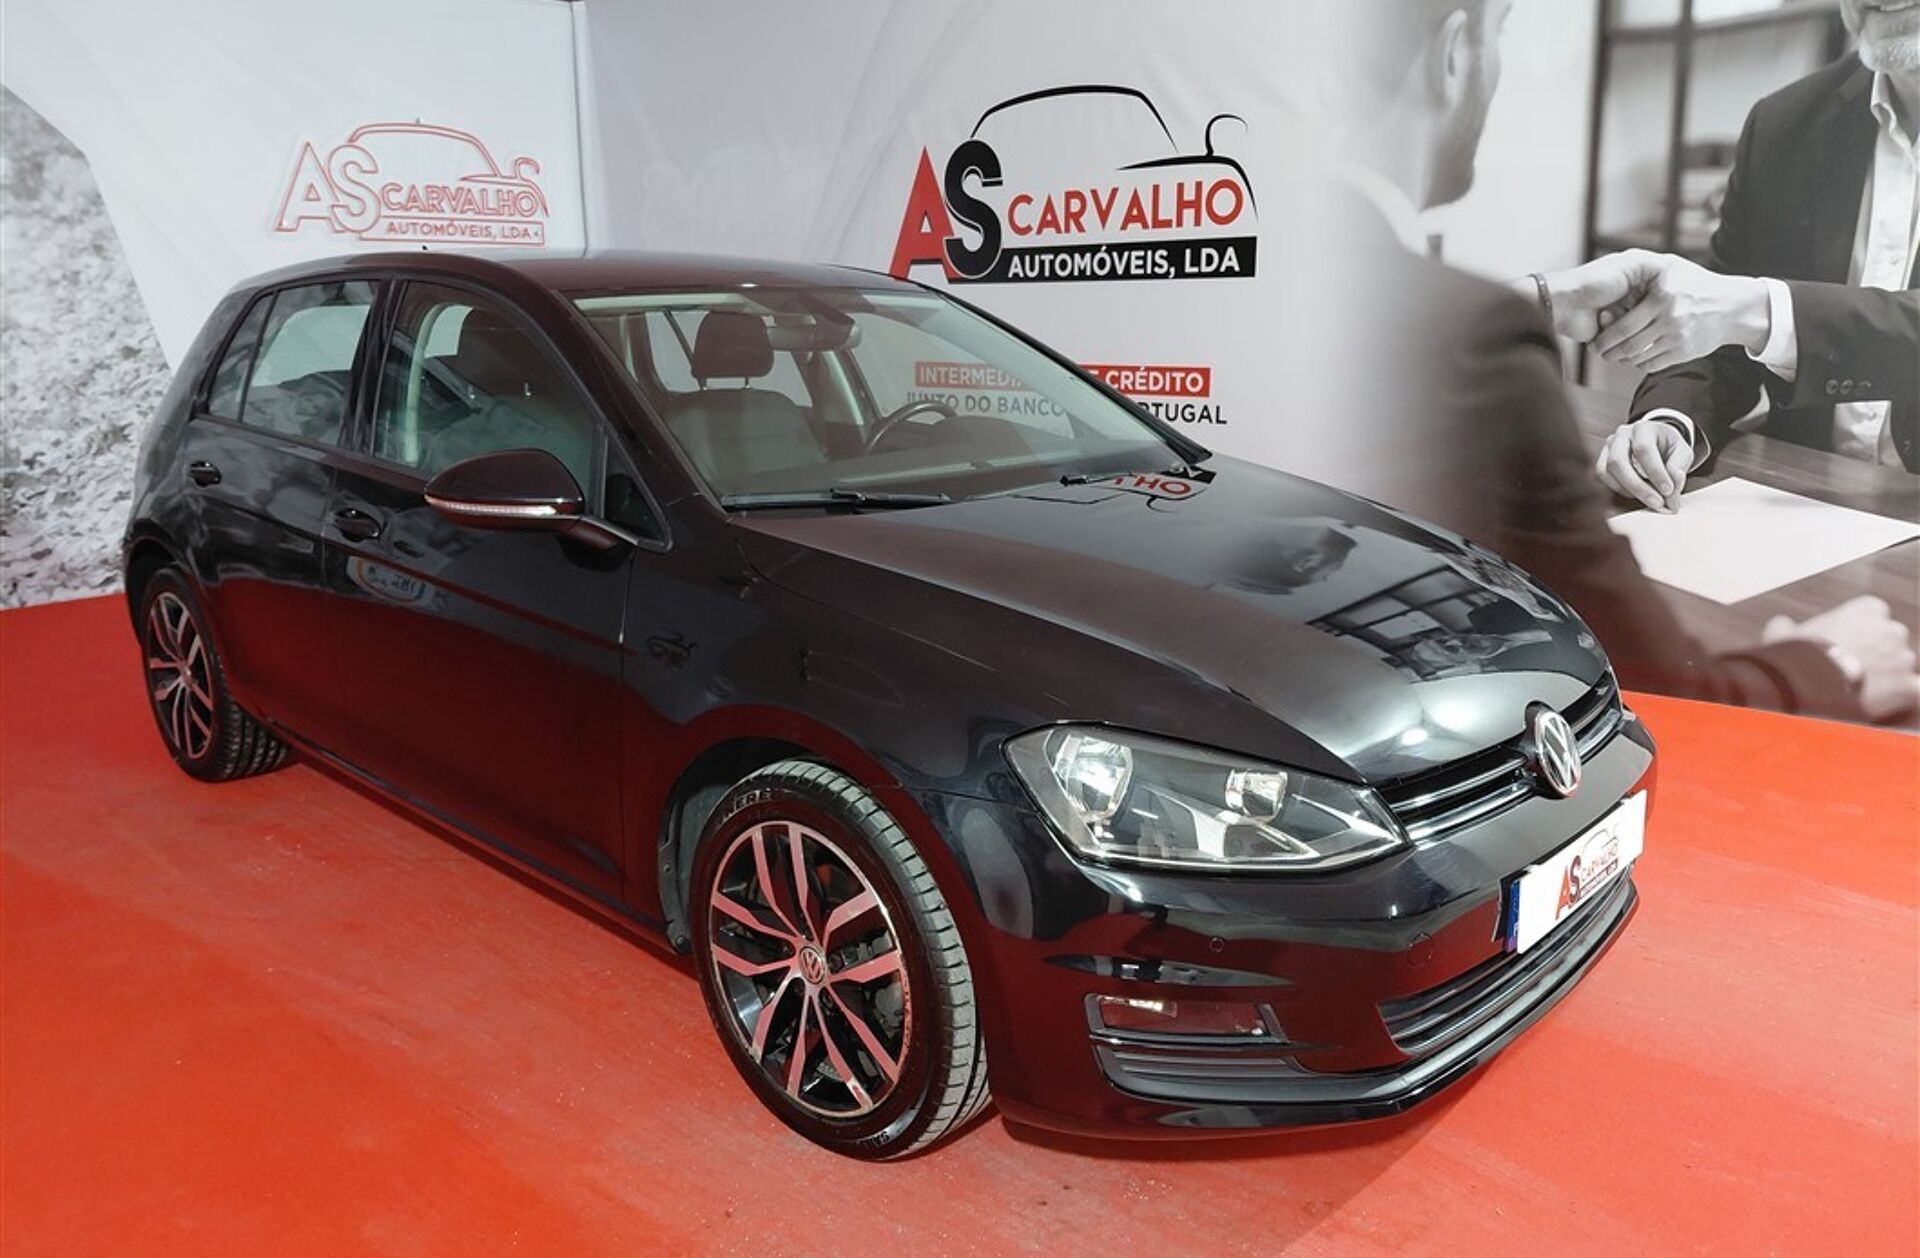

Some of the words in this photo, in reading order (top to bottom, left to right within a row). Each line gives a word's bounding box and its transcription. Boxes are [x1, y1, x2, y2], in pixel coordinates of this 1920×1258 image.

[276, 141, 381, 233] AS
[379, 182, 538, 217] CARVALHO
[889, 139, 1003, 282] AS
[1008, 178, 1244, 236] CARVALHO
[386, 220, 497, 240] AUTOMÓVEIS,
[501, 221, 531, 239] LDA
[1008, 246, 1176, 280] AUTOMÓVEIS,
[1184, 246, 1240, 274] LDA
[1105, 367, 1204, 393] CRÉDITO
[965, 395, 991, 413] DO
[997, 397, 1066, 416] BANCO
